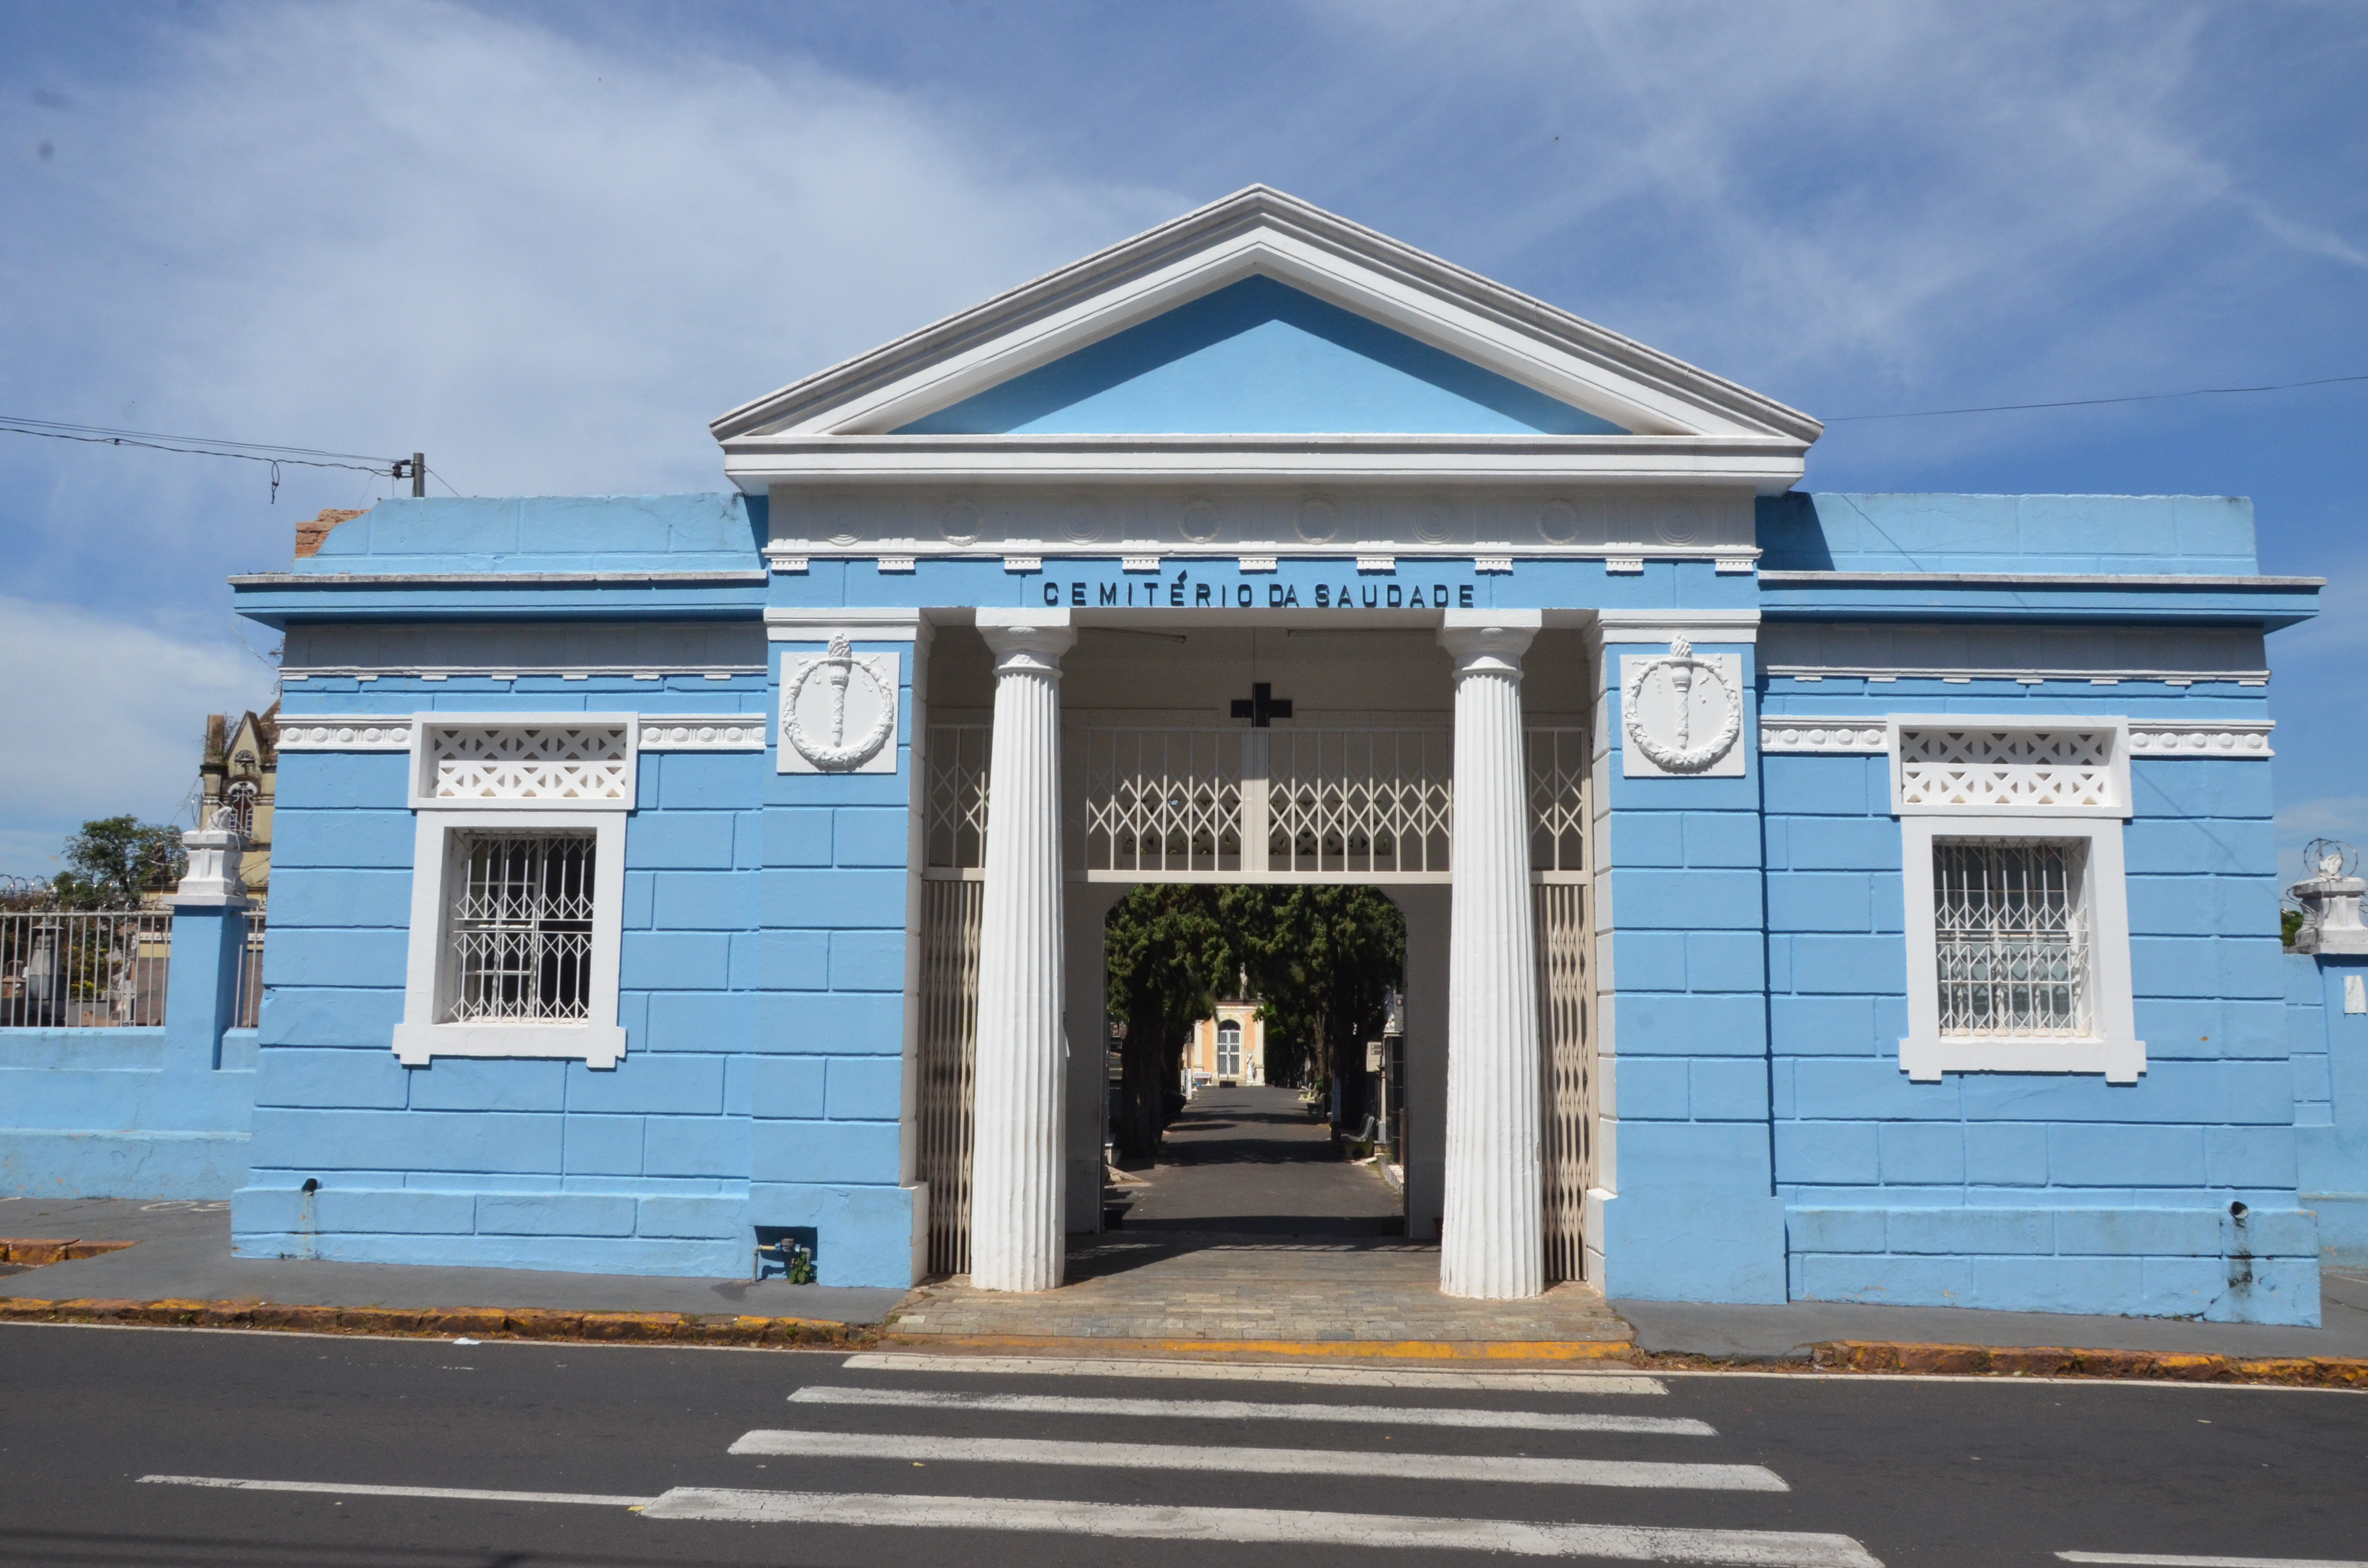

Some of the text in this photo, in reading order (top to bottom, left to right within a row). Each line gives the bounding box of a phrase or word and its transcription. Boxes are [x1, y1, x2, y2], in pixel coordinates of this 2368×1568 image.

[1044, 569, 1474, 608] CEMITÉRIO DA SAUDADE
